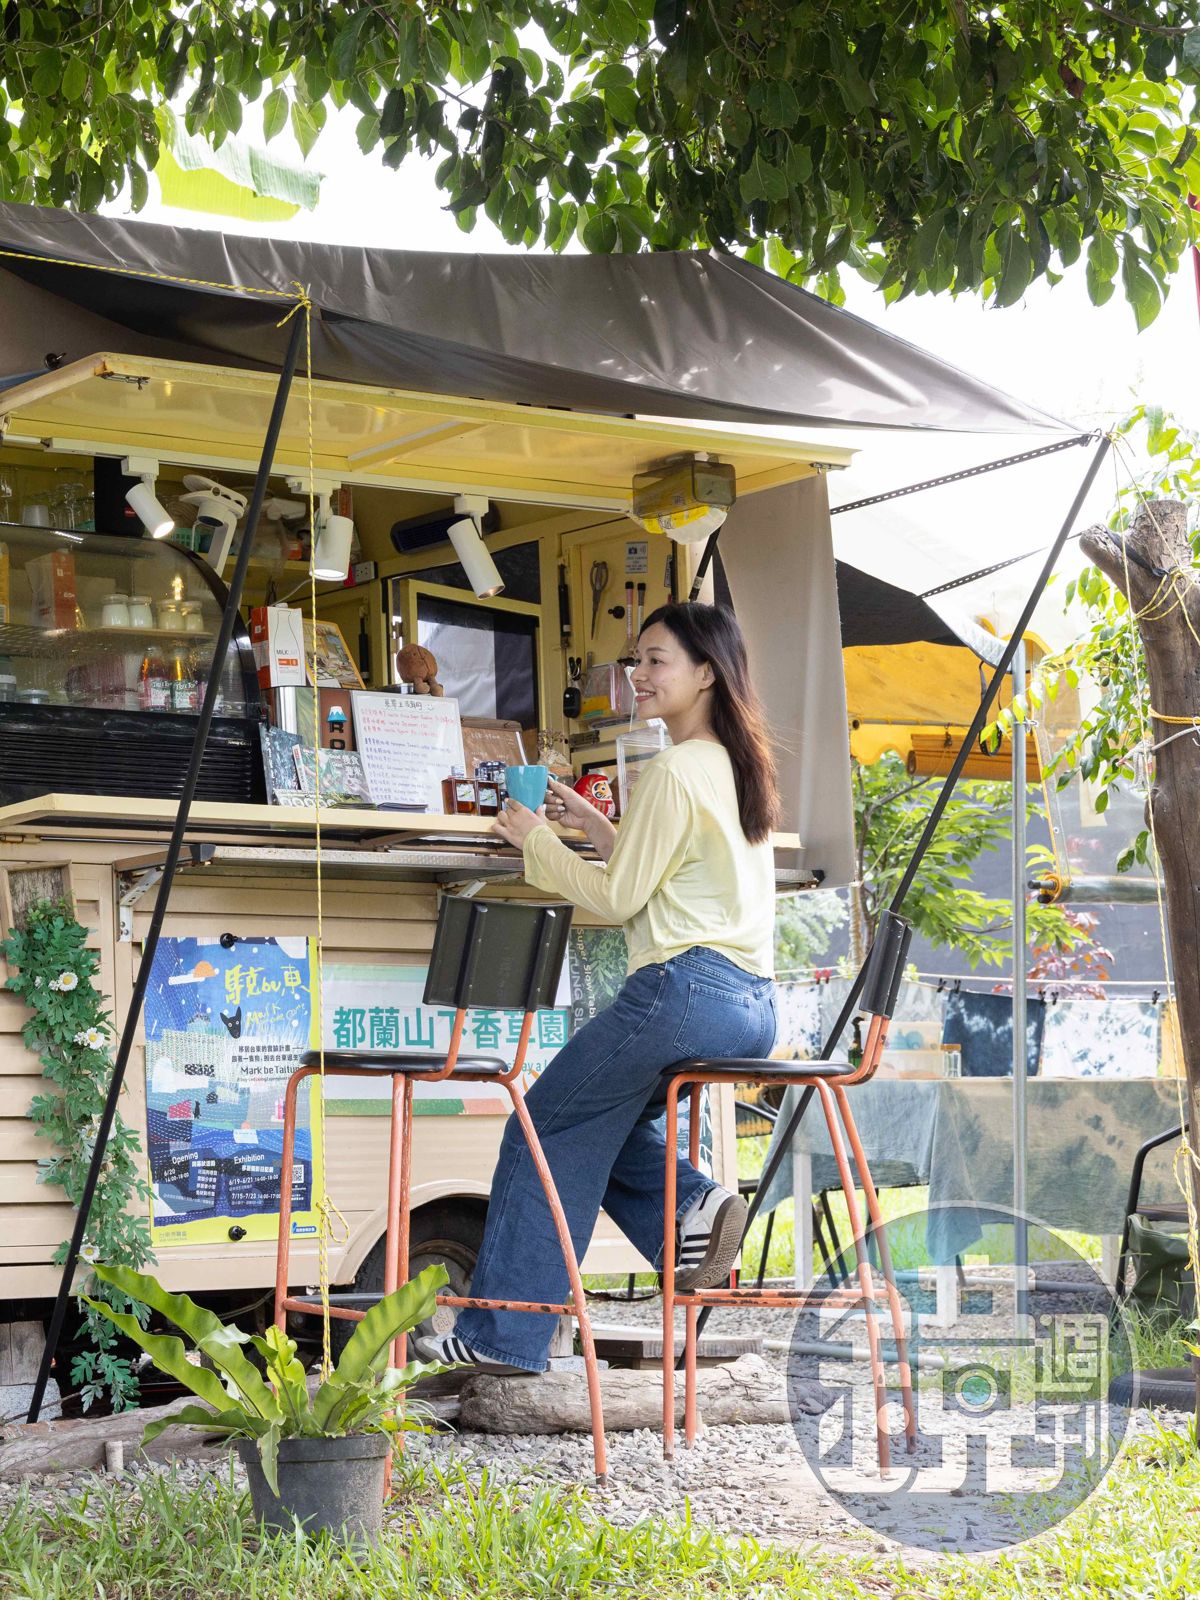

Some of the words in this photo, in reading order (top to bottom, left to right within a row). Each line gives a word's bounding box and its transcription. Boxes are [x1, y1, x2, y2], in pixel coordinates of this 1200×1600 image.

[576, 928, 588, 961] Super
[583, 964, 594, 992] Slow
[588, 994, 597, 1019] Tabl
[240, 1067, 262, 1075] Mark
[263, 1066, 274, 1074] be
[274, 1065, 300, 1074] Taitun
[171, 1152, 199, 1165] Opening
[233, 1153, 265, 1165] Exhibition
[164, 1168, 176, 1177] 6/20
